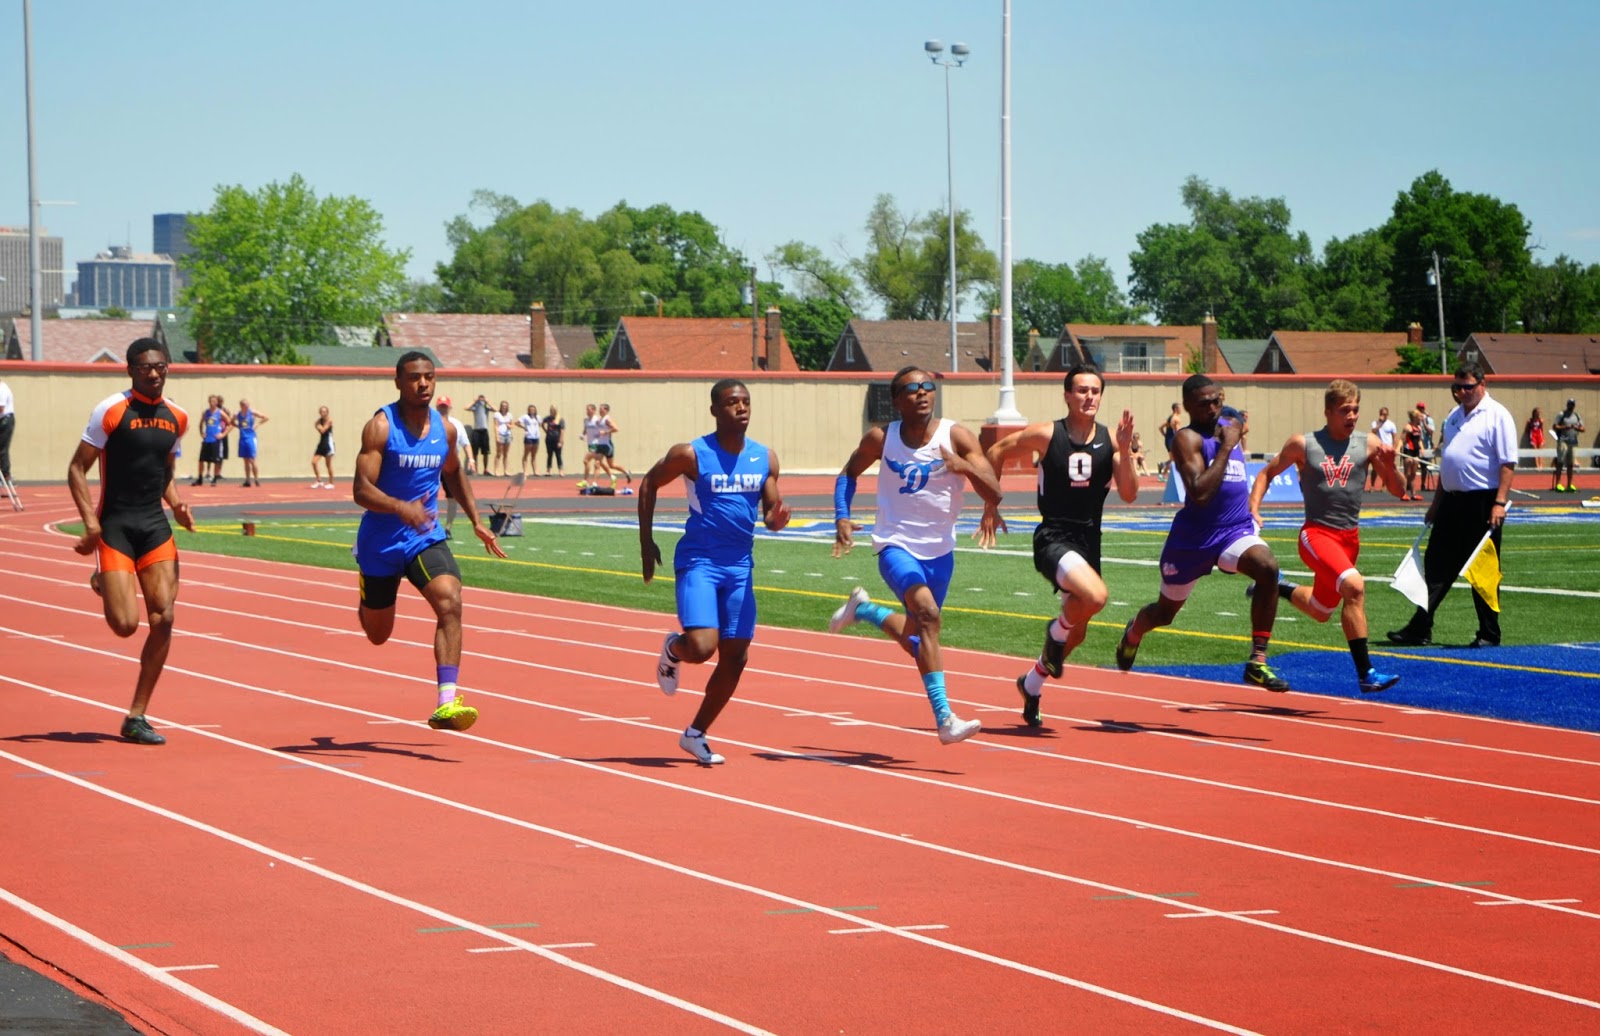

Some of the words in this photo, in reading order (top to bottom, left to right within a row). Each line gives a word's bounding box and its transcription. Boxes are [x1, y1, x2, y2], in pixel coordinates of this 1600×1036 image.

[399, 453, 441, 468] WYOMING
[711, 473, 762, 493] CLARK
[899, 463, 929, 494] D
